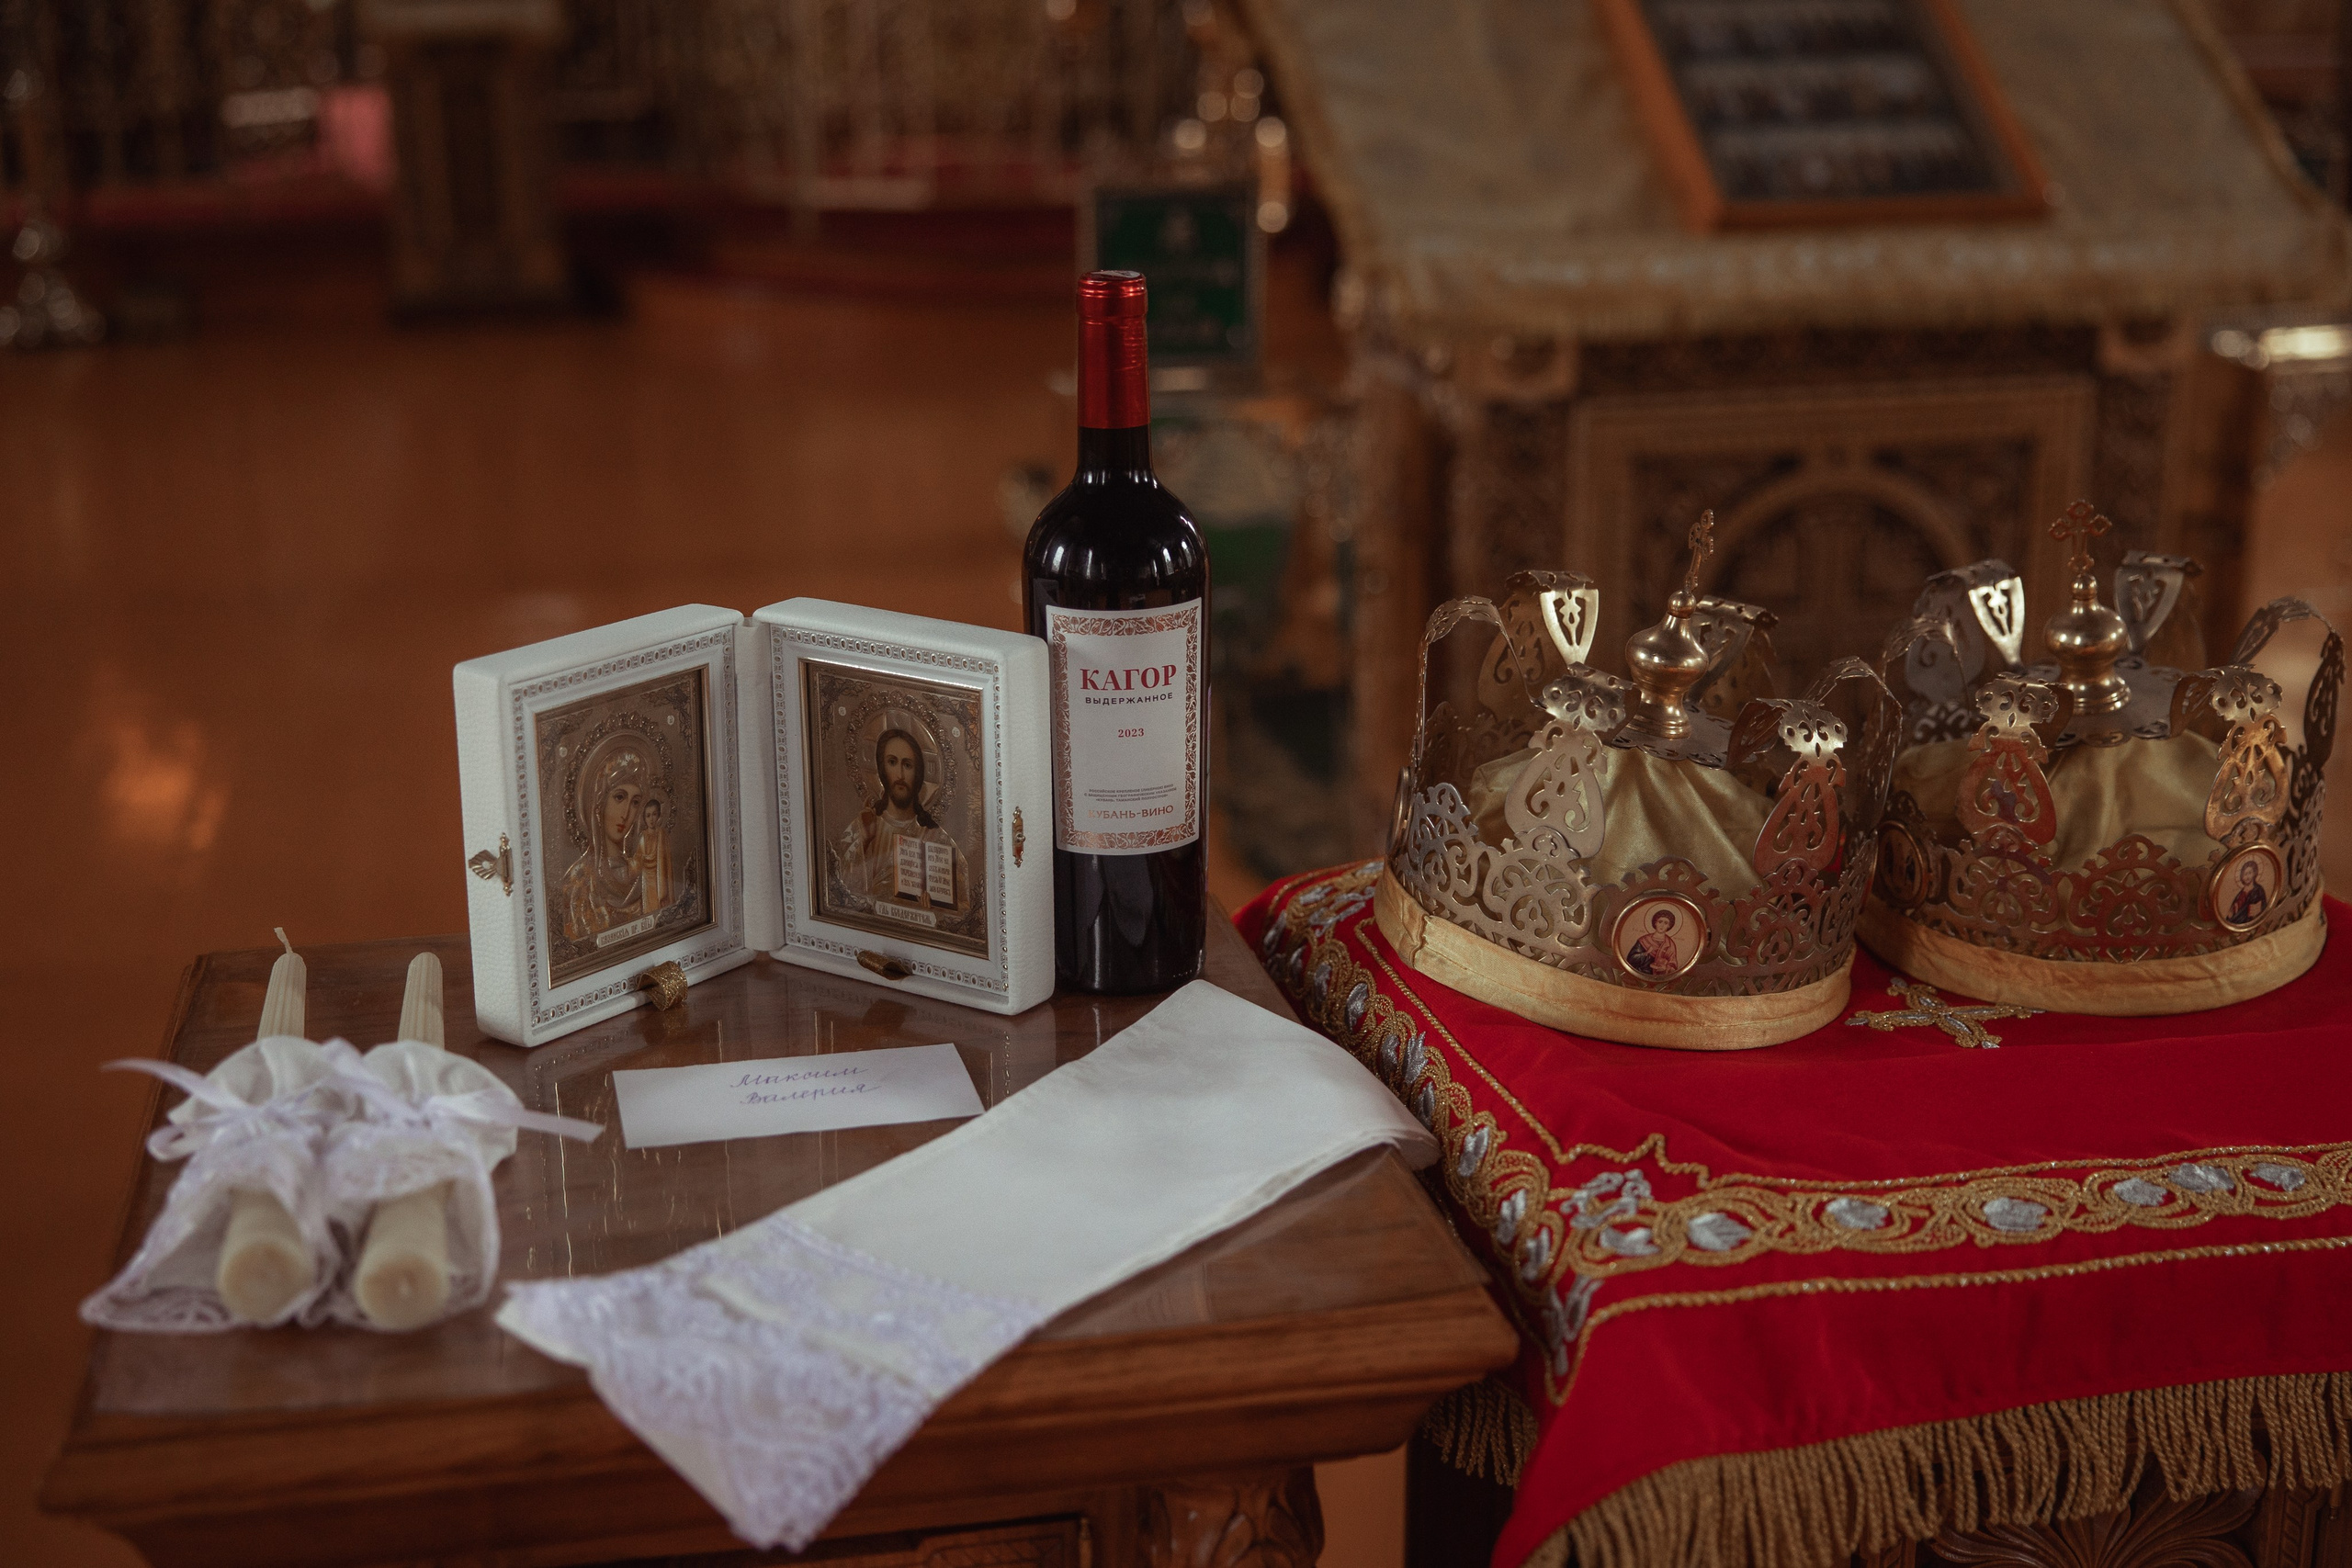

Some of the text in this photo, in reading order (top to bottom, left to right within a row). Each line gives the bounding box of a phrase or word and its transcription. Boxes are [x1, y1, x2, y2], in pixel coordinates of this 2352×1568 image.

[1080, 664, 1177, 691] КАГОР
[1085, 693, 1173, 705] ВЫДЕРЖАННОЕ
[1118, 728, 1145, 738] 2023
[1089, 805, 1174, 818] КУБАНЬ-ВИНО
[730, 1066, 869, 1088] Максим
[740, 1083, 882, 1105] Валерия
